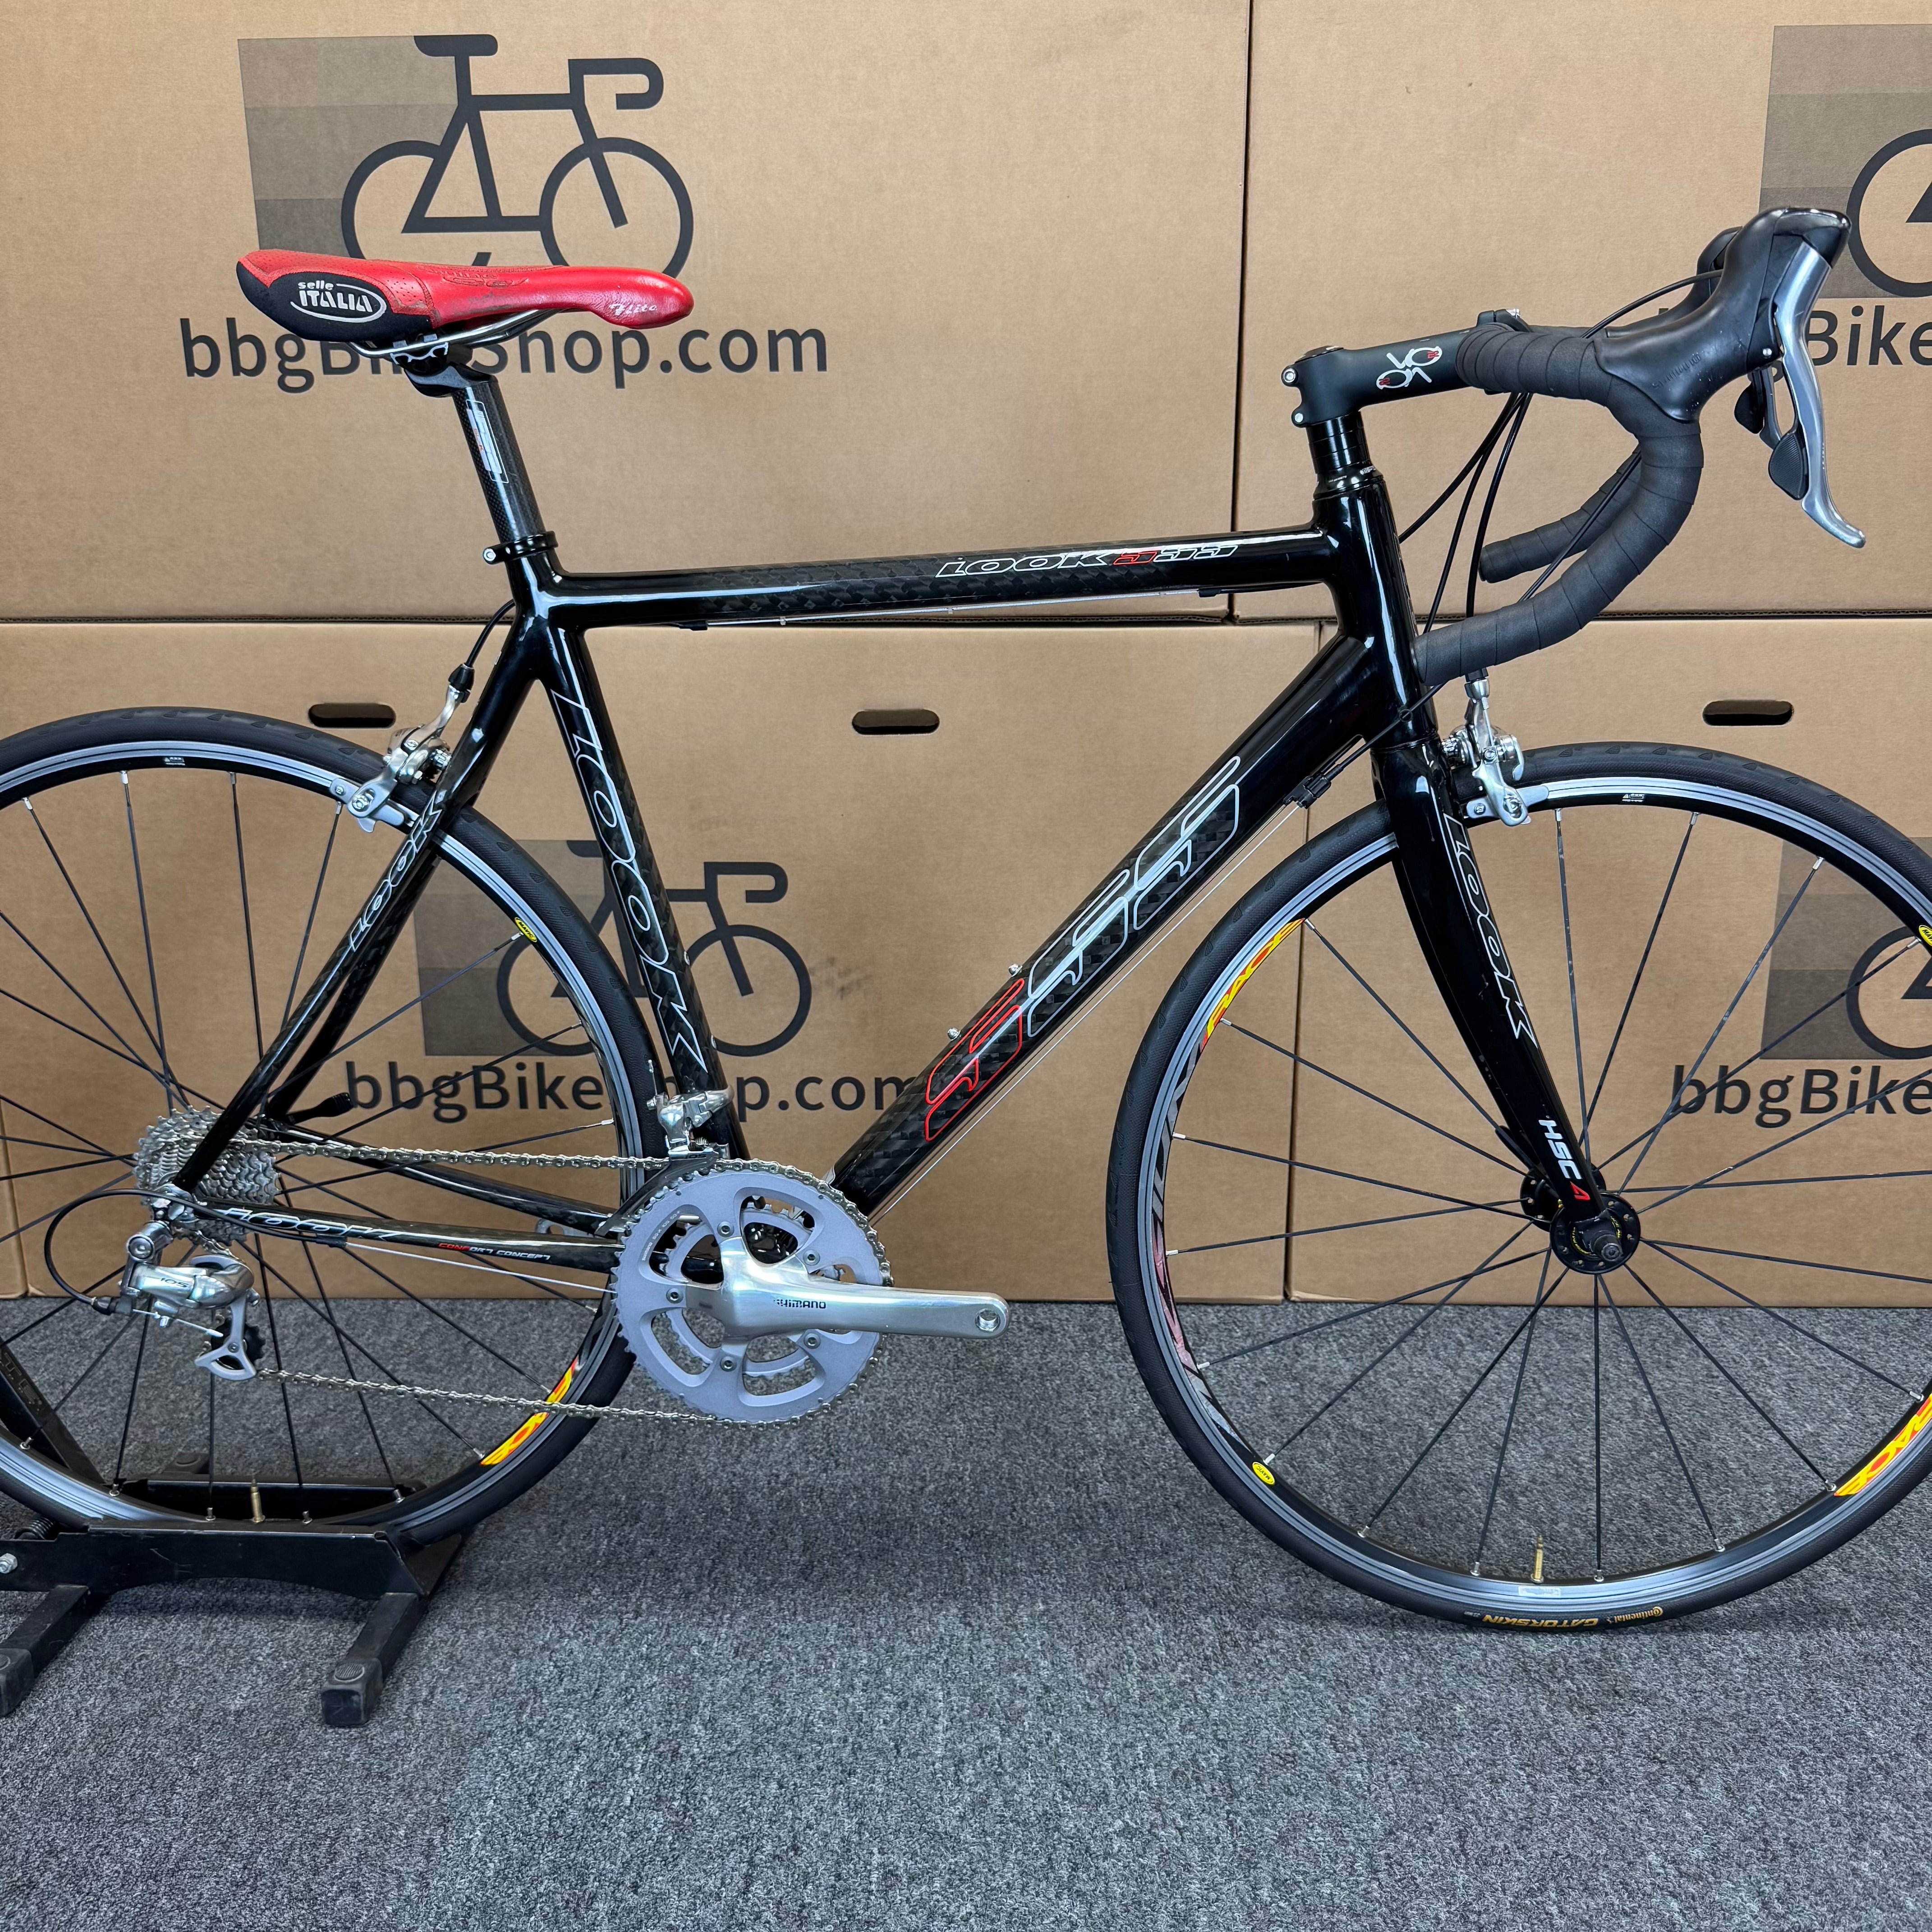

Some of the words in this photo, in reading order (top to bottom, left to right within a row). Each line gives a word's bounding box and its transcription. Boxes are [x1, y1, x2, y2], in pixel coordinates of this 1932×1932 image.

[298, 281, 334, 290] selle
[299, 290, 373, 312] ITALIA
[179, 317, 828, 394] bbgBShop.com
[936, 552, 1109, 578] LOOK
[349, 790, 443, 952] LOOK
[551, 689, 708, 1073] LOOK
[518, 922, 534, 938] MAVIC
[1444, 813, 1538, 1048] LOOK
[346, 1061, 916, 1124] bbgBikep.co
[1671, 1065, 1932, 1128] bbgBike
[1538, 1120, 1582, 1179] HSC
[437, 1242, 493, 1254] CONFORT
[496, 1250, 551, 1260] CONCEPT
[1256, 1466, 1271, 1480] MAVIC
[1482, 1614, 1599, 1627] GATORSKIN
[1614, 1606, 1663, 1623] Continental
